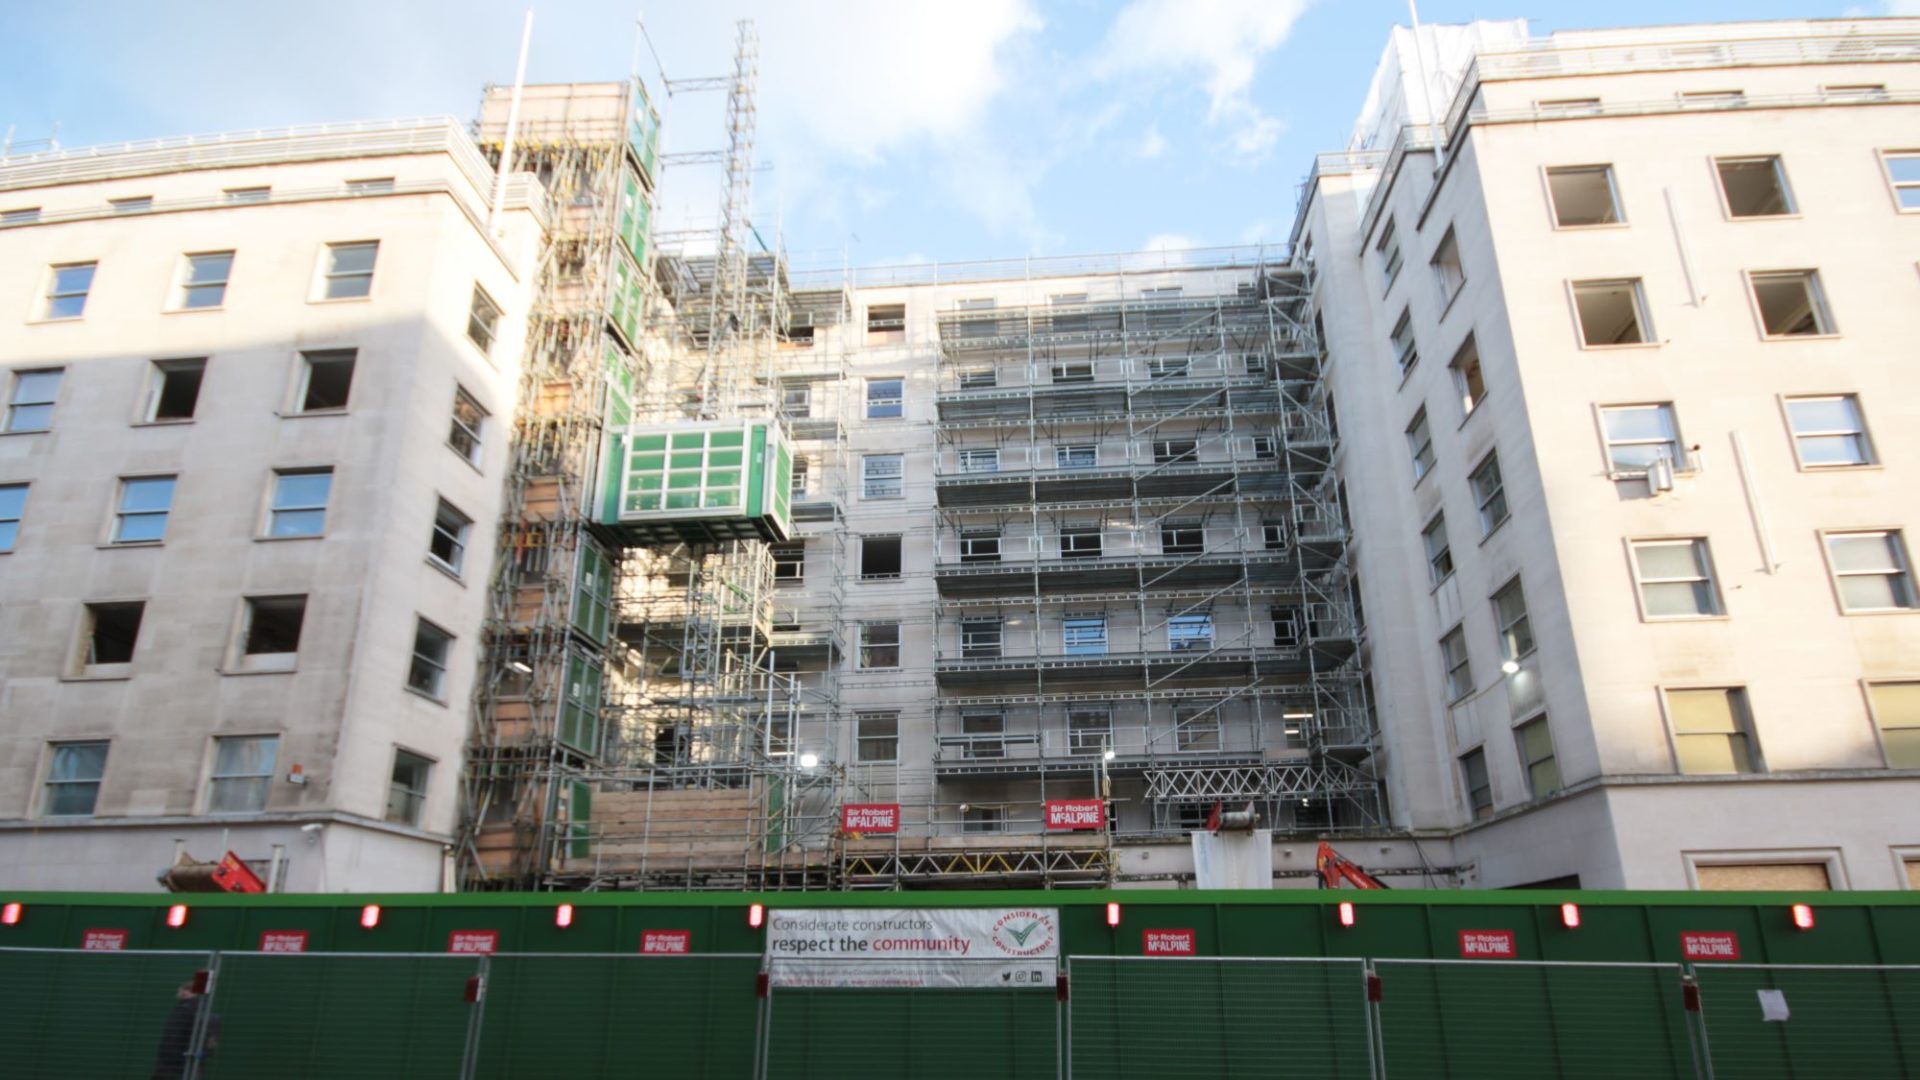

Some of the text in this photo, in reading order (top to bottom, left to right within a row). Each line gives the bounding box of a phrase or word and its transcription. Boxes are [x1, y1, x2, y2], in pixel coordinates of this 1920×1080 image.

[847, 816, 894, 828] McALPINE
[1051, 812, 1099, 824] McALPINE
[772, 918, 933, 931] Considerate constructors
[992, 911, 1053, 931] CONSIDERATE
[772, 936, 971, 955] respect the community
[992, 935, 1054, 955] CONSTRUCTORS
